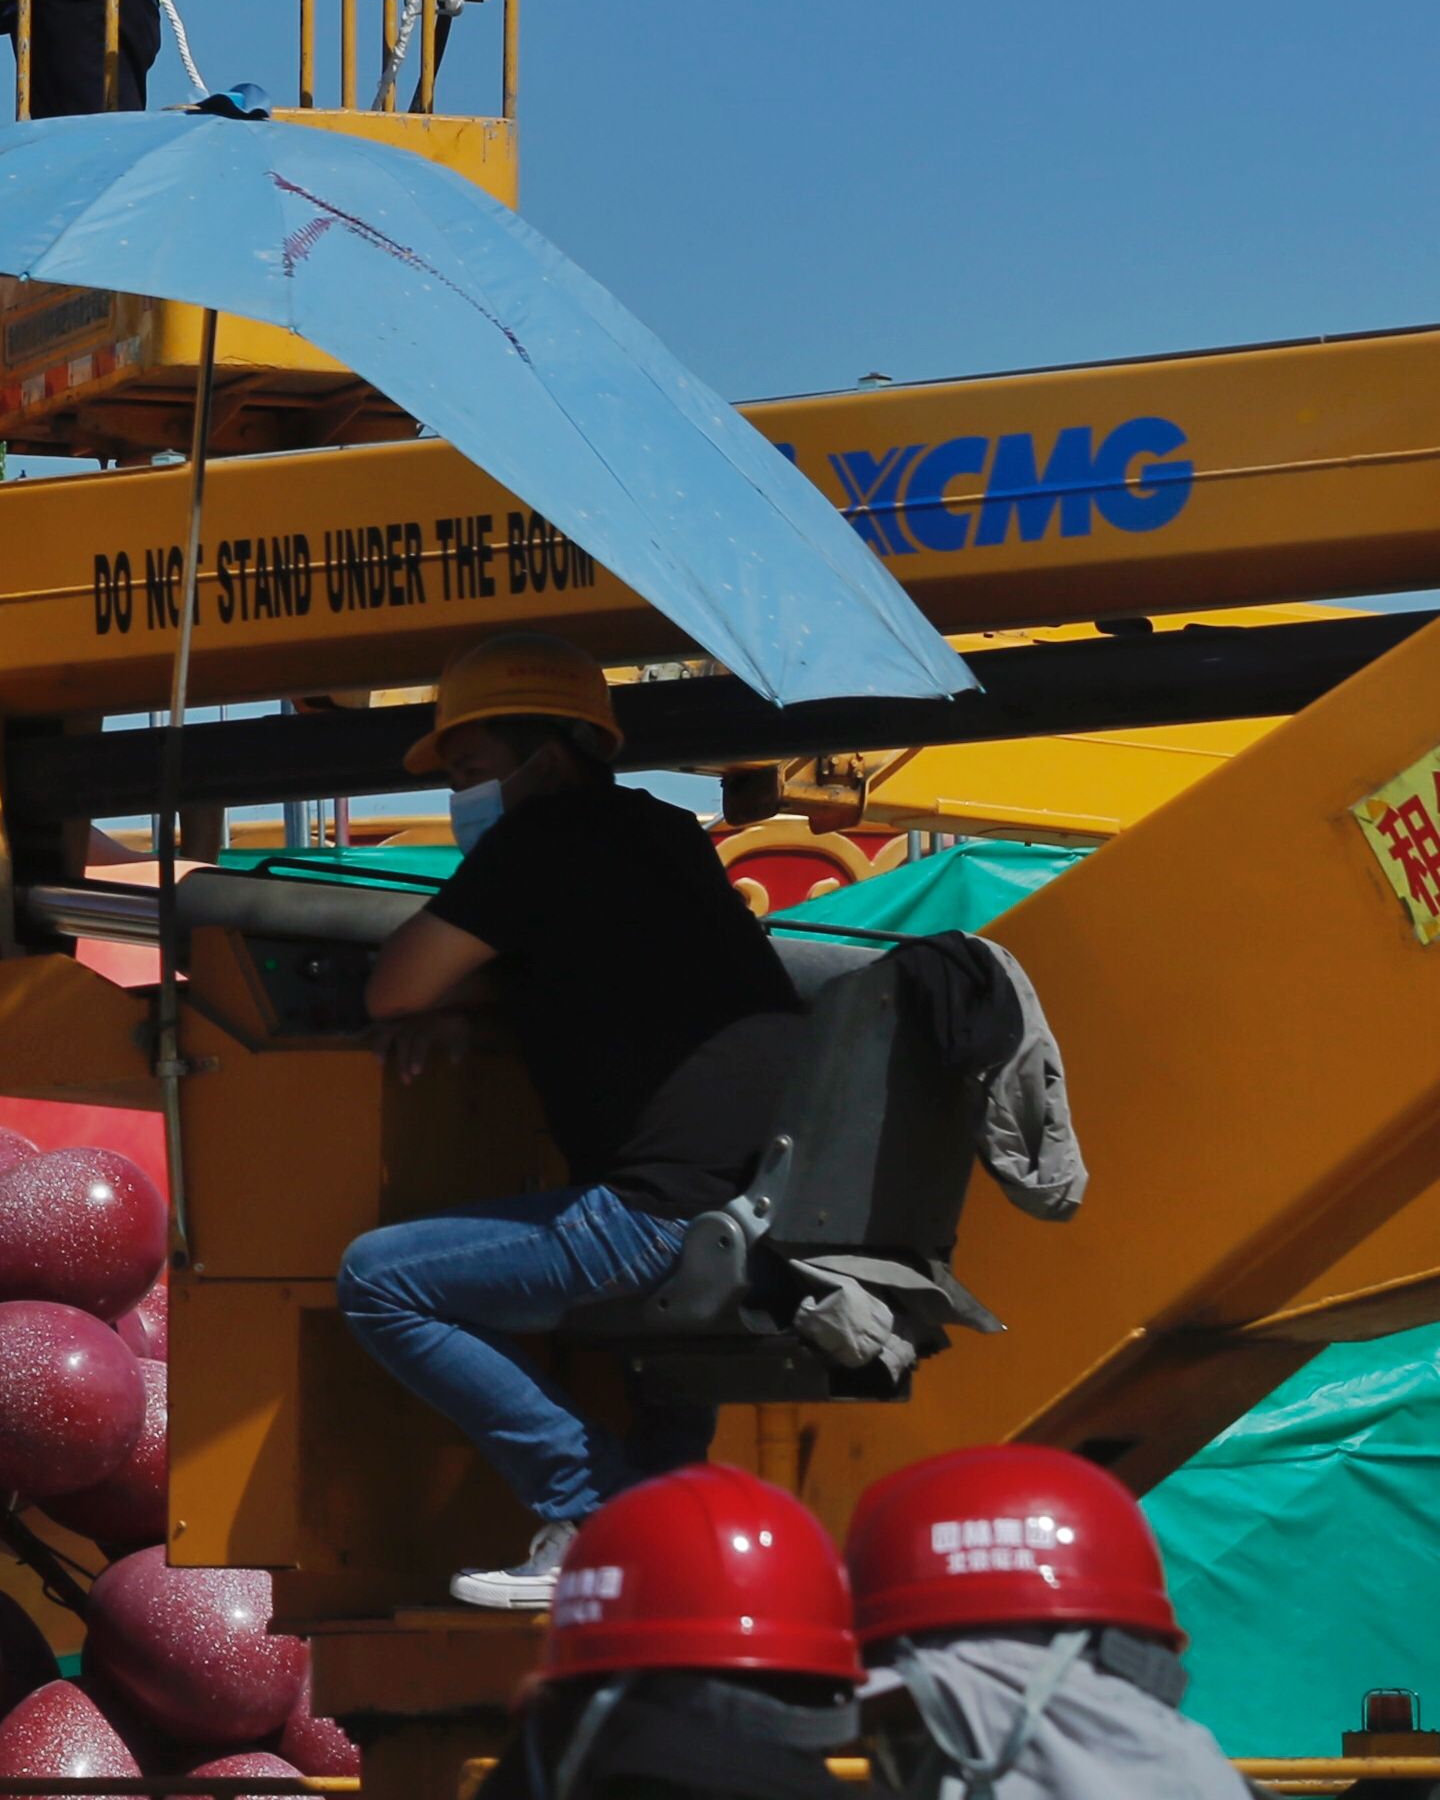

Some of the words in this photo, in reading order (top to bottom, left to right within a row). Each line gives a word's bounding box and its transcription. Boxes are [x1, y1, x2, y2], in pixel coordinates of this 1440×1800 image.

[827, 416, 1194, 557] XCMG
[94, 552, 131, 634] DO
[217, 534, 312, 624] STAND
[324, 522, 426, 613] UNDER
[436, 514, 496, 601] THE
